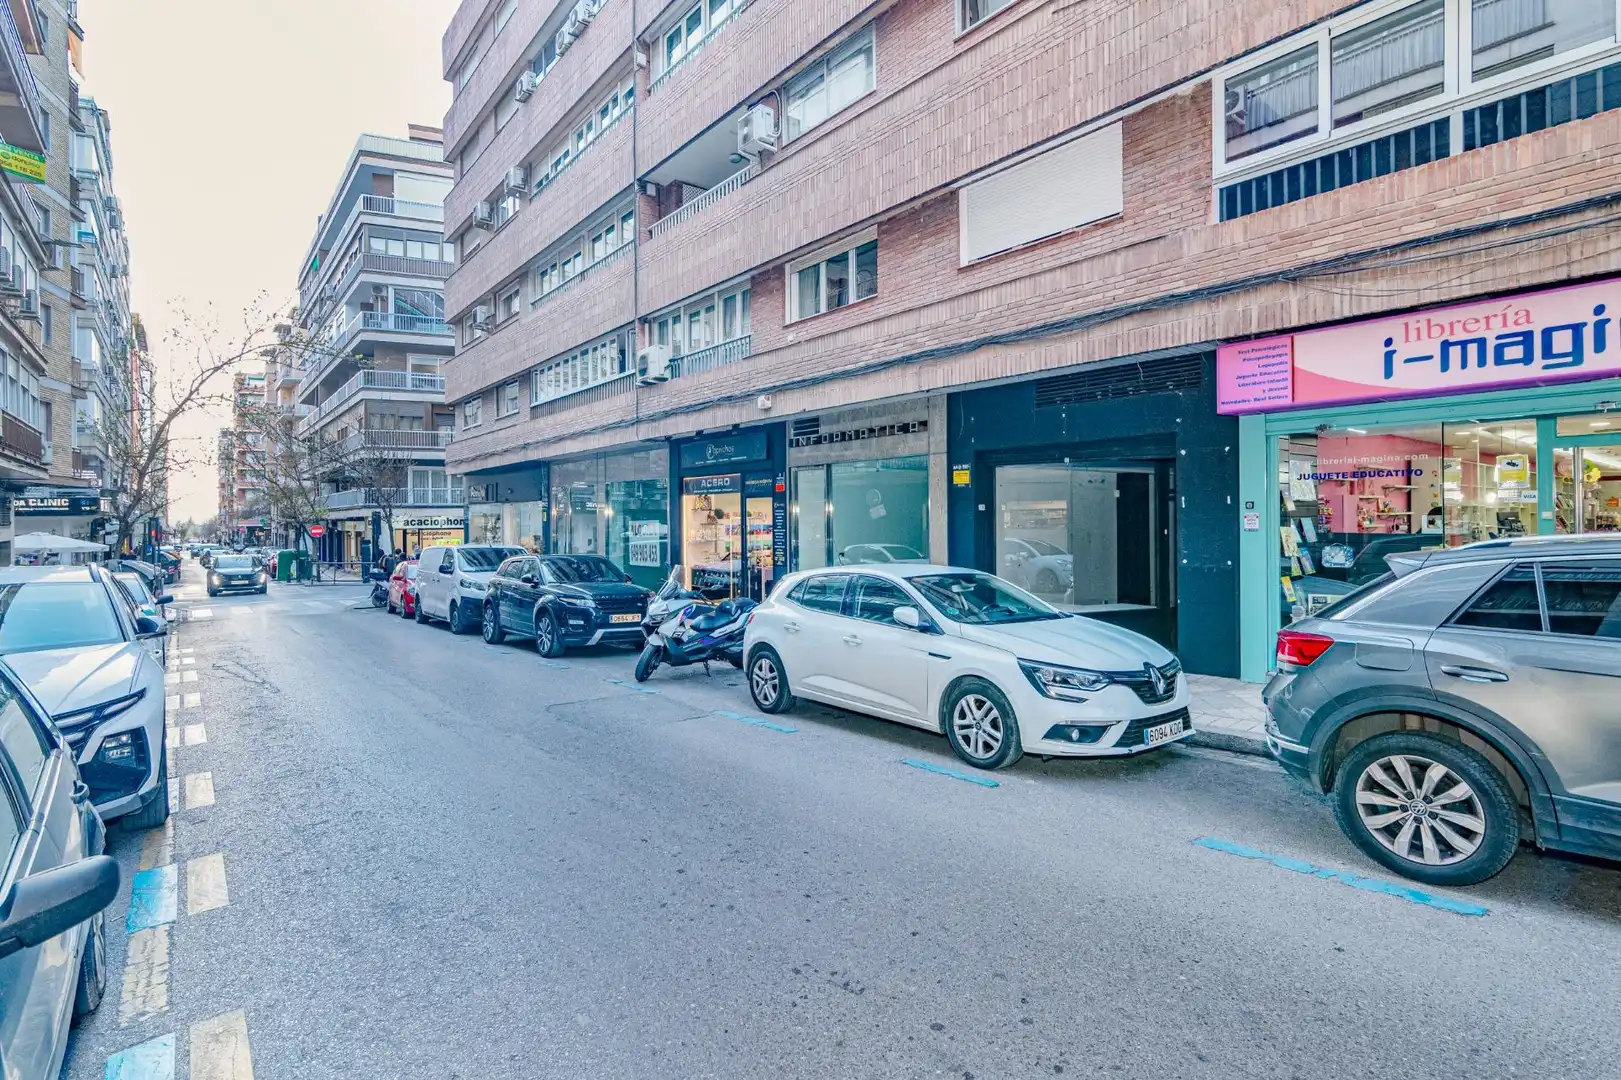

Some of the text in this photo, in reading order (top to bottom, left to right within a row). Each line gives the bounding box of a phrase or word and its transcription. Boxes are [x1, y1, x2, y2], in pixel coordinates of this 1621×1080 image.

[1403, 304, 1534, 343] librería
[1384, 303, 1621, 380] i-magi
[792, 421, 919, 447] INFORMATICA
[700, 477, 731, 488] ACERO
[1296, 468, 1424, 481] JUGUETE EDUCATIVO
[28, 498, 70, 507] CLINIC
[1149, 726, 1168, 742] 6094
